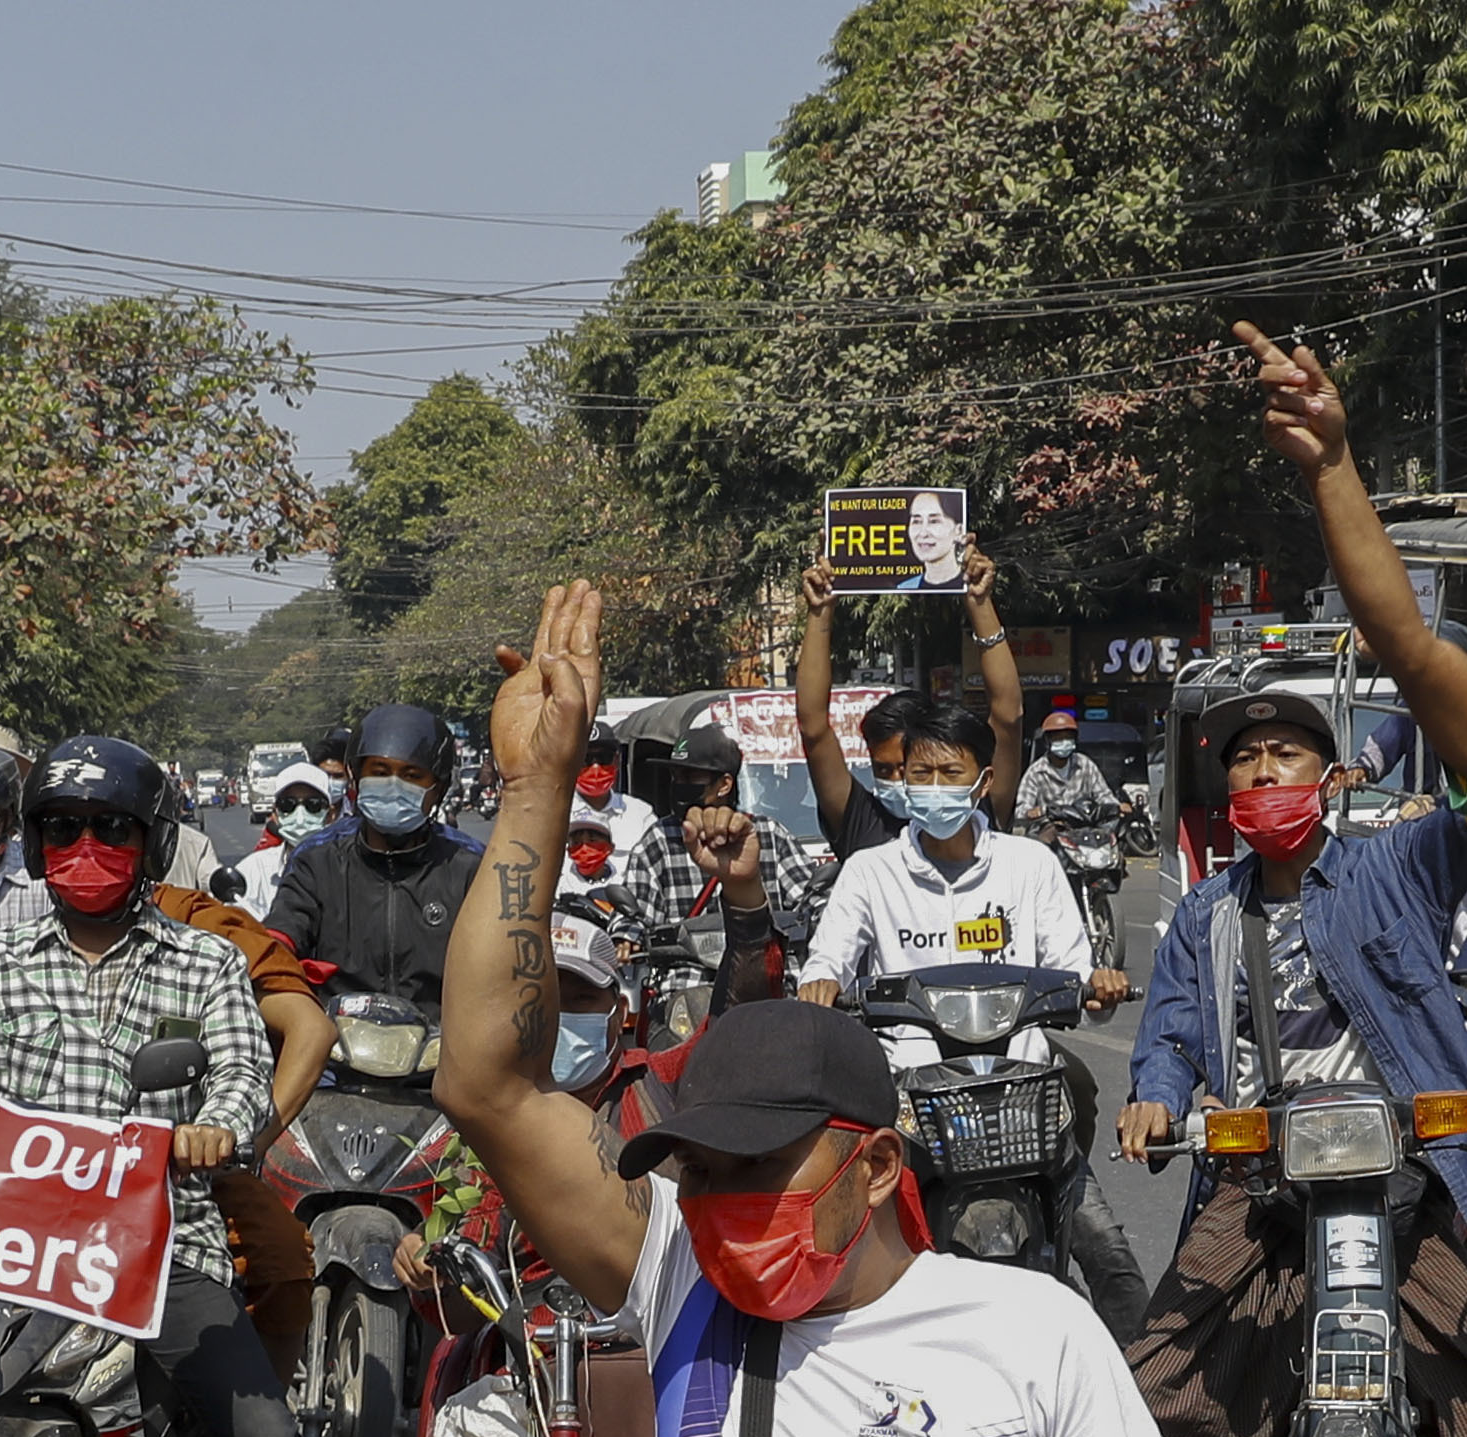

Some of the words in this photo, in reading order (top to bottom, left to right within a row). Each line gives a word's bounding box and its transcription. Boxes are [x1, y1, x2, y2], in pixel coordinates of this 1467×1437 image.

[830, 499, 841, 511] WE
[842, 499, 861, 511] WANT
[863, 499, 877, 510] OUR
[878, 498, 907, 510] LEADER
[831, 524, 907, 557] FREE
[849, 565, 874, 576] AUNG
[876, 565, 894, 575] SAN
[896, 565, 908, 575] SU
[957, 923, 1000, 946] hub
[10, 1124, 142, 1199] Our
